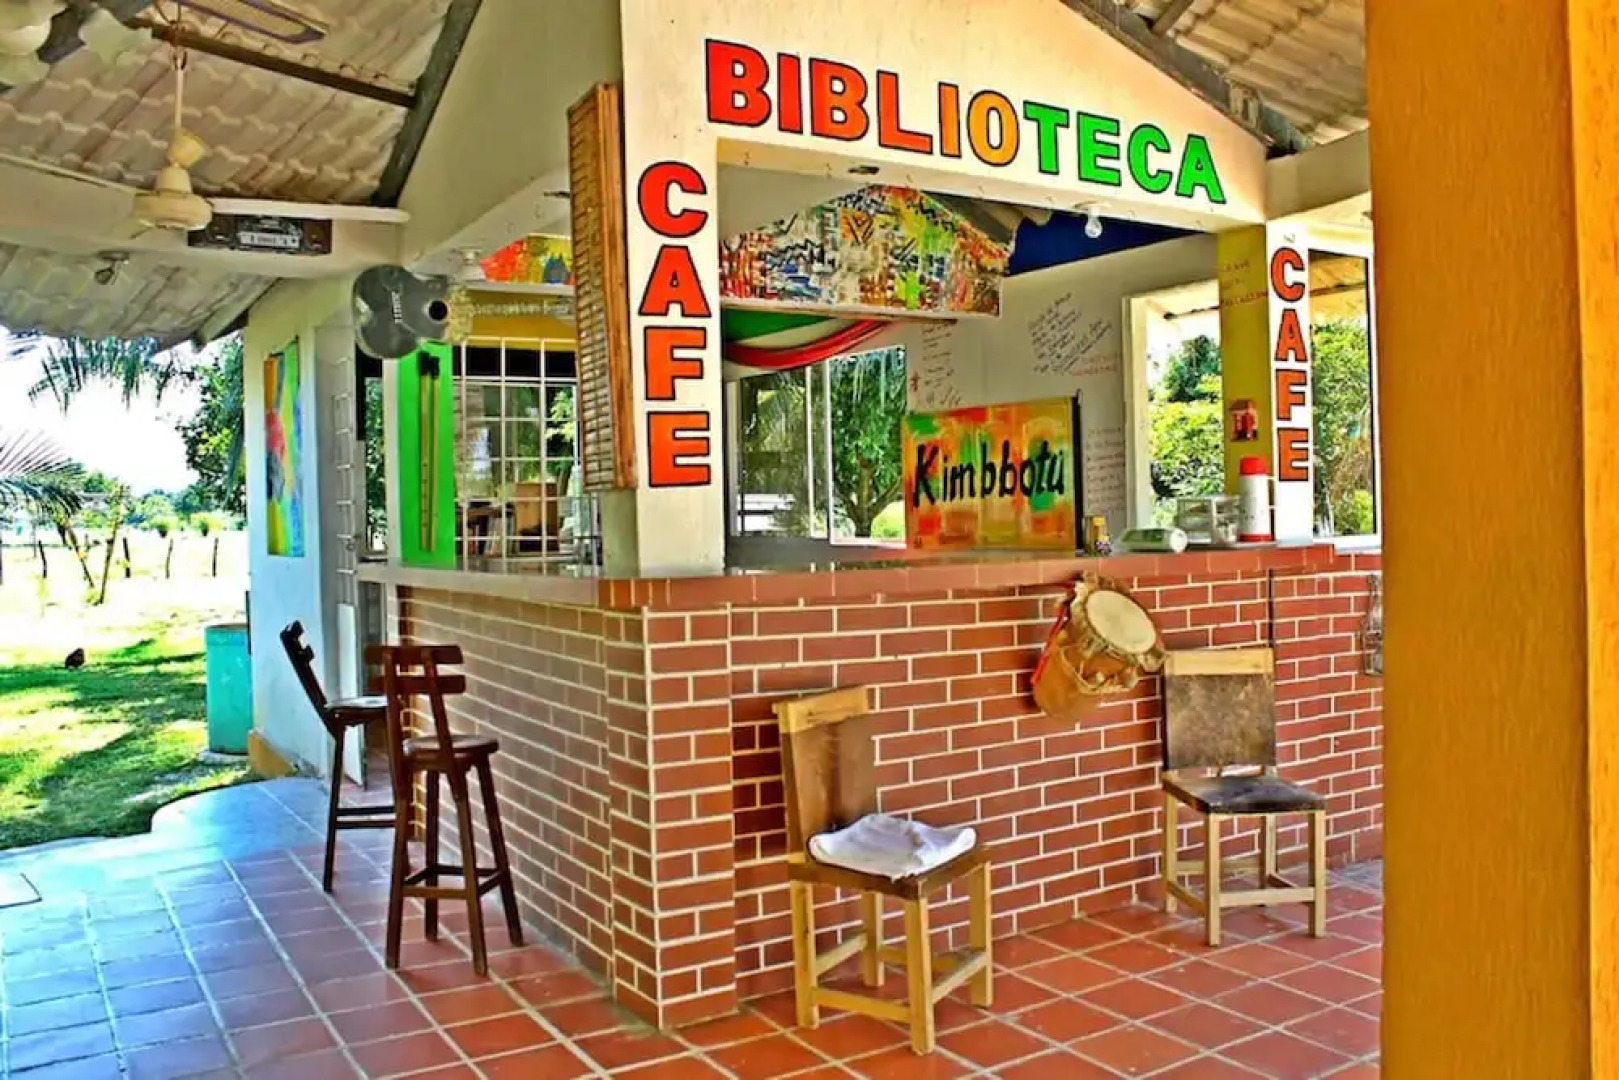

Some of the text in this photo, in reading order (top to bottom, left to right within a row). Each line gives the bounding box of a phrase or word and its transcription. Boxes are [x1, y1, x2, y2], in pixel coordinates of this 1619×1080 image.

[705, 38, 1227, 204] BIBLIOTECA
[637, 160, 712, 488] CAFE
[1270, 247, 1310, 482] CAFE
